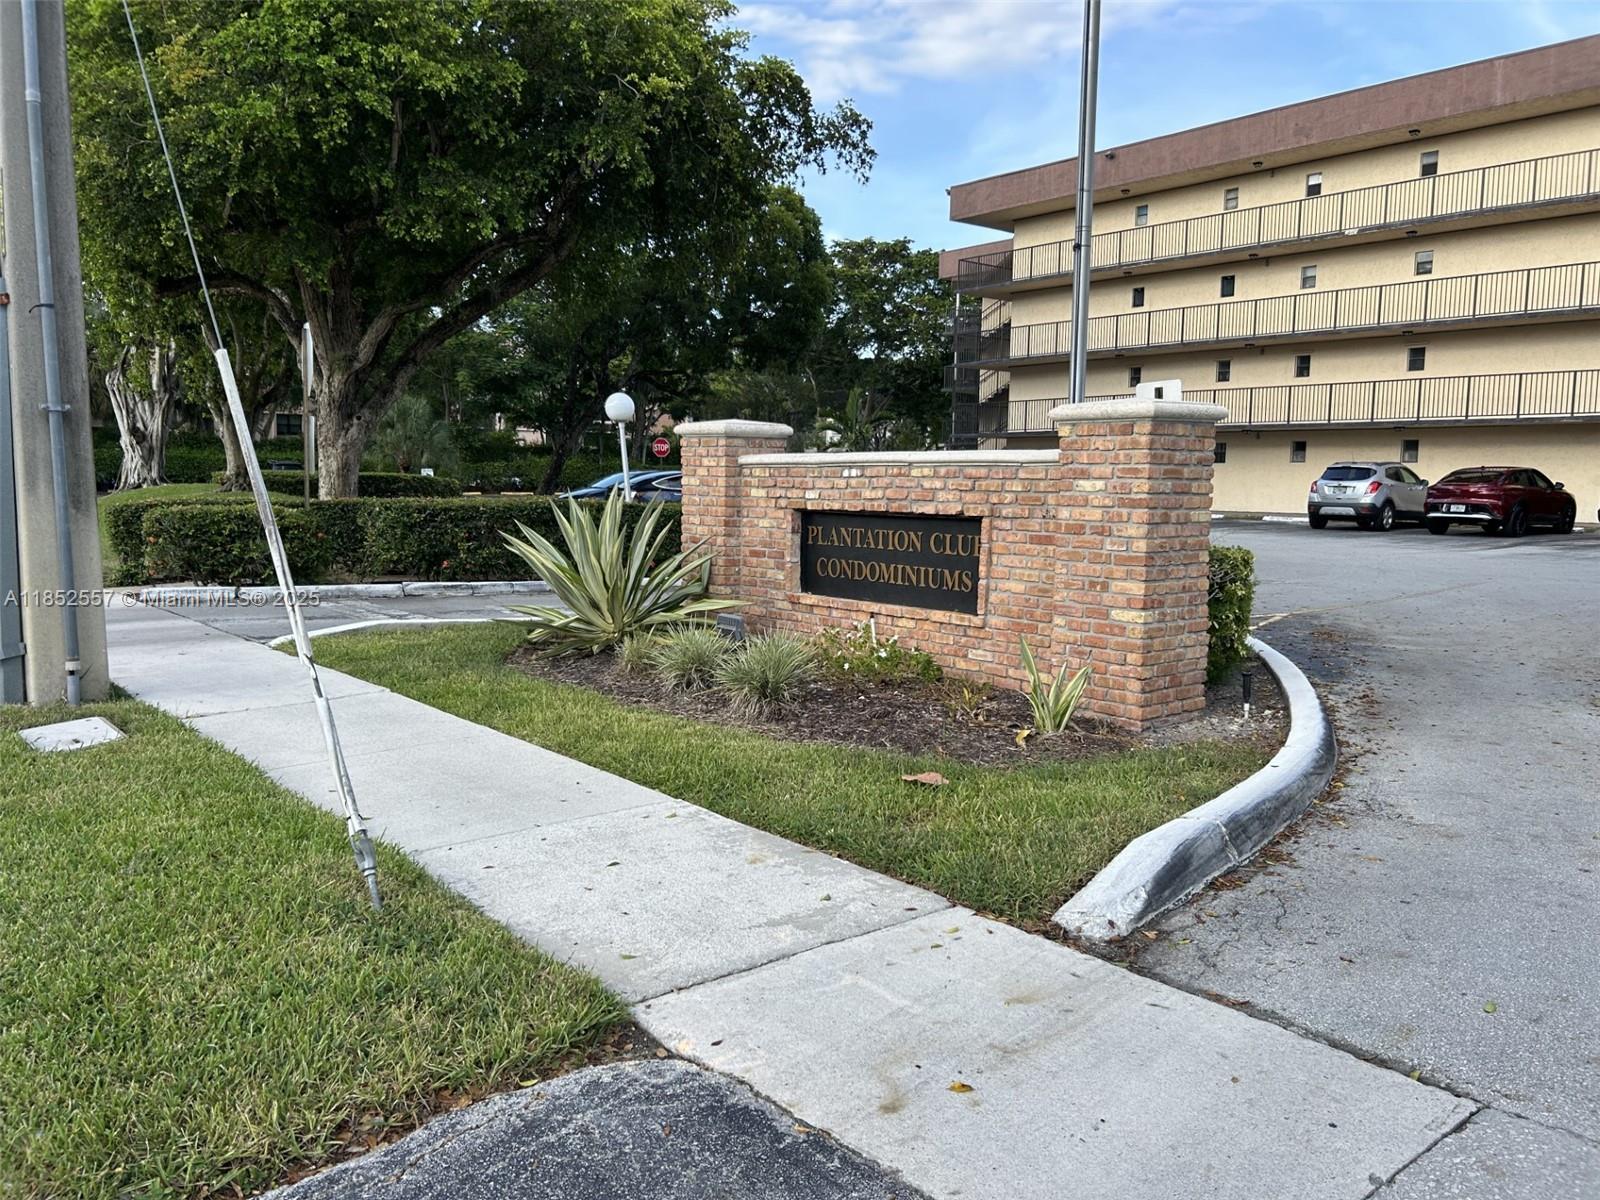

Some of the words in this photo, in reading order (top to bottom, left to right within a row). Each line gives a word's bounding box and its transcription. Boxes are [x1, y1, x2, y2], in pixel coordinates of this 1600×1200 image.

[654, 443, 669, 451] STOP
[807, 525, 923, 552] PLANTATION
[816, 557, 972, 592] CONDOMINIUMS
